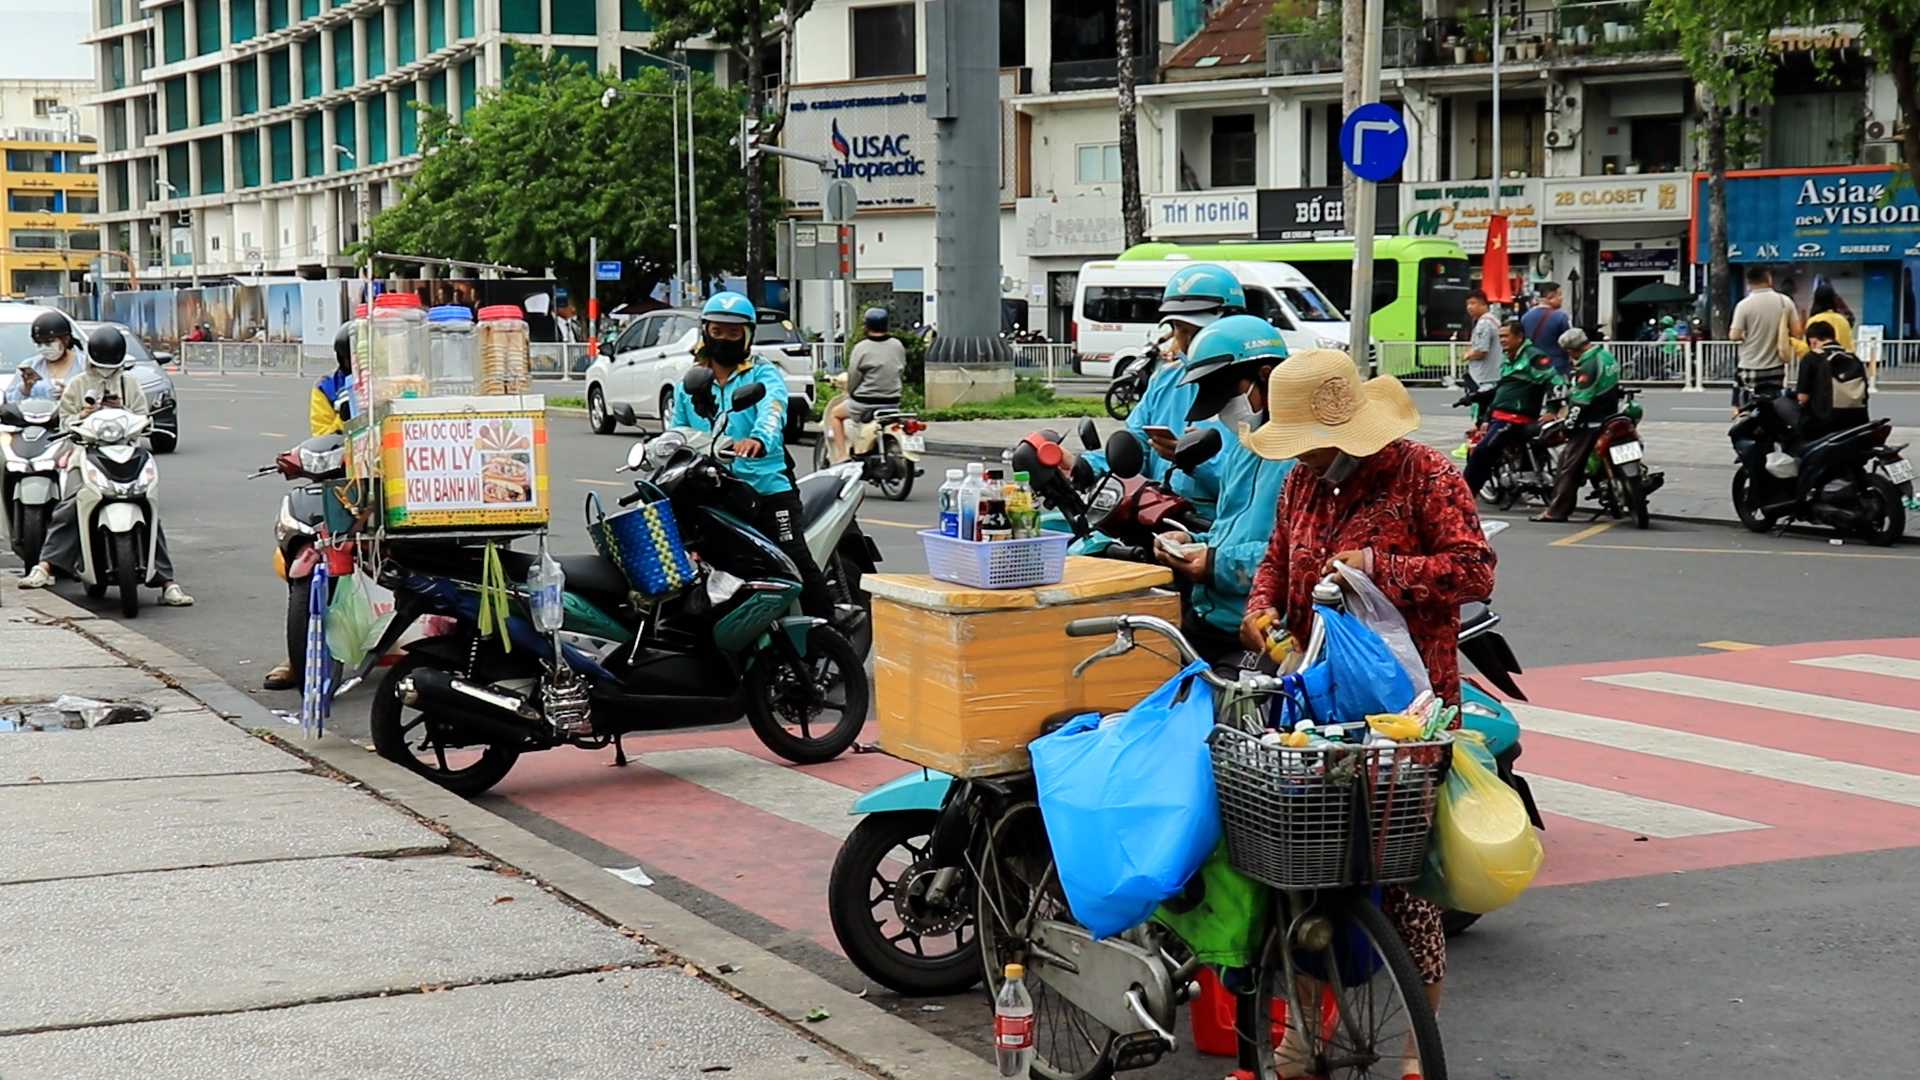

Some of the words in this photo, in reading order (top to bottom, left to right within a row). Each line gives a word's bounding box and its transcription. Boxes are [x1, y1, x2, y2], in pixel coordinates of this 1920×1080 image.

[853, 134, 910, 159] USAC
[1555, 190, 1575, 206] 2B
[1579, 188, 1648, 205] CLOSET
[1796, 177, 1866, 205] Asia
[1161, 198, 1188, 223] TÍN
[1295, 195, 1321, 223] BỐ
[1324, 201, 1345, 222] GI
[1794, 215, 1824, 226] new
[1823, 205, 1920, 226] vision
[1839, 244, 1891, 254] BURBERRY
[404, 423, 429, 441] KEM
[406, 447, 446, 472] KEM
[452, 446, 473, 470] LY
[407, 478, 432, 503] KEM
[434, 473, 465, 502] BÁNH
[468, 473, 481, 502] MÌ
